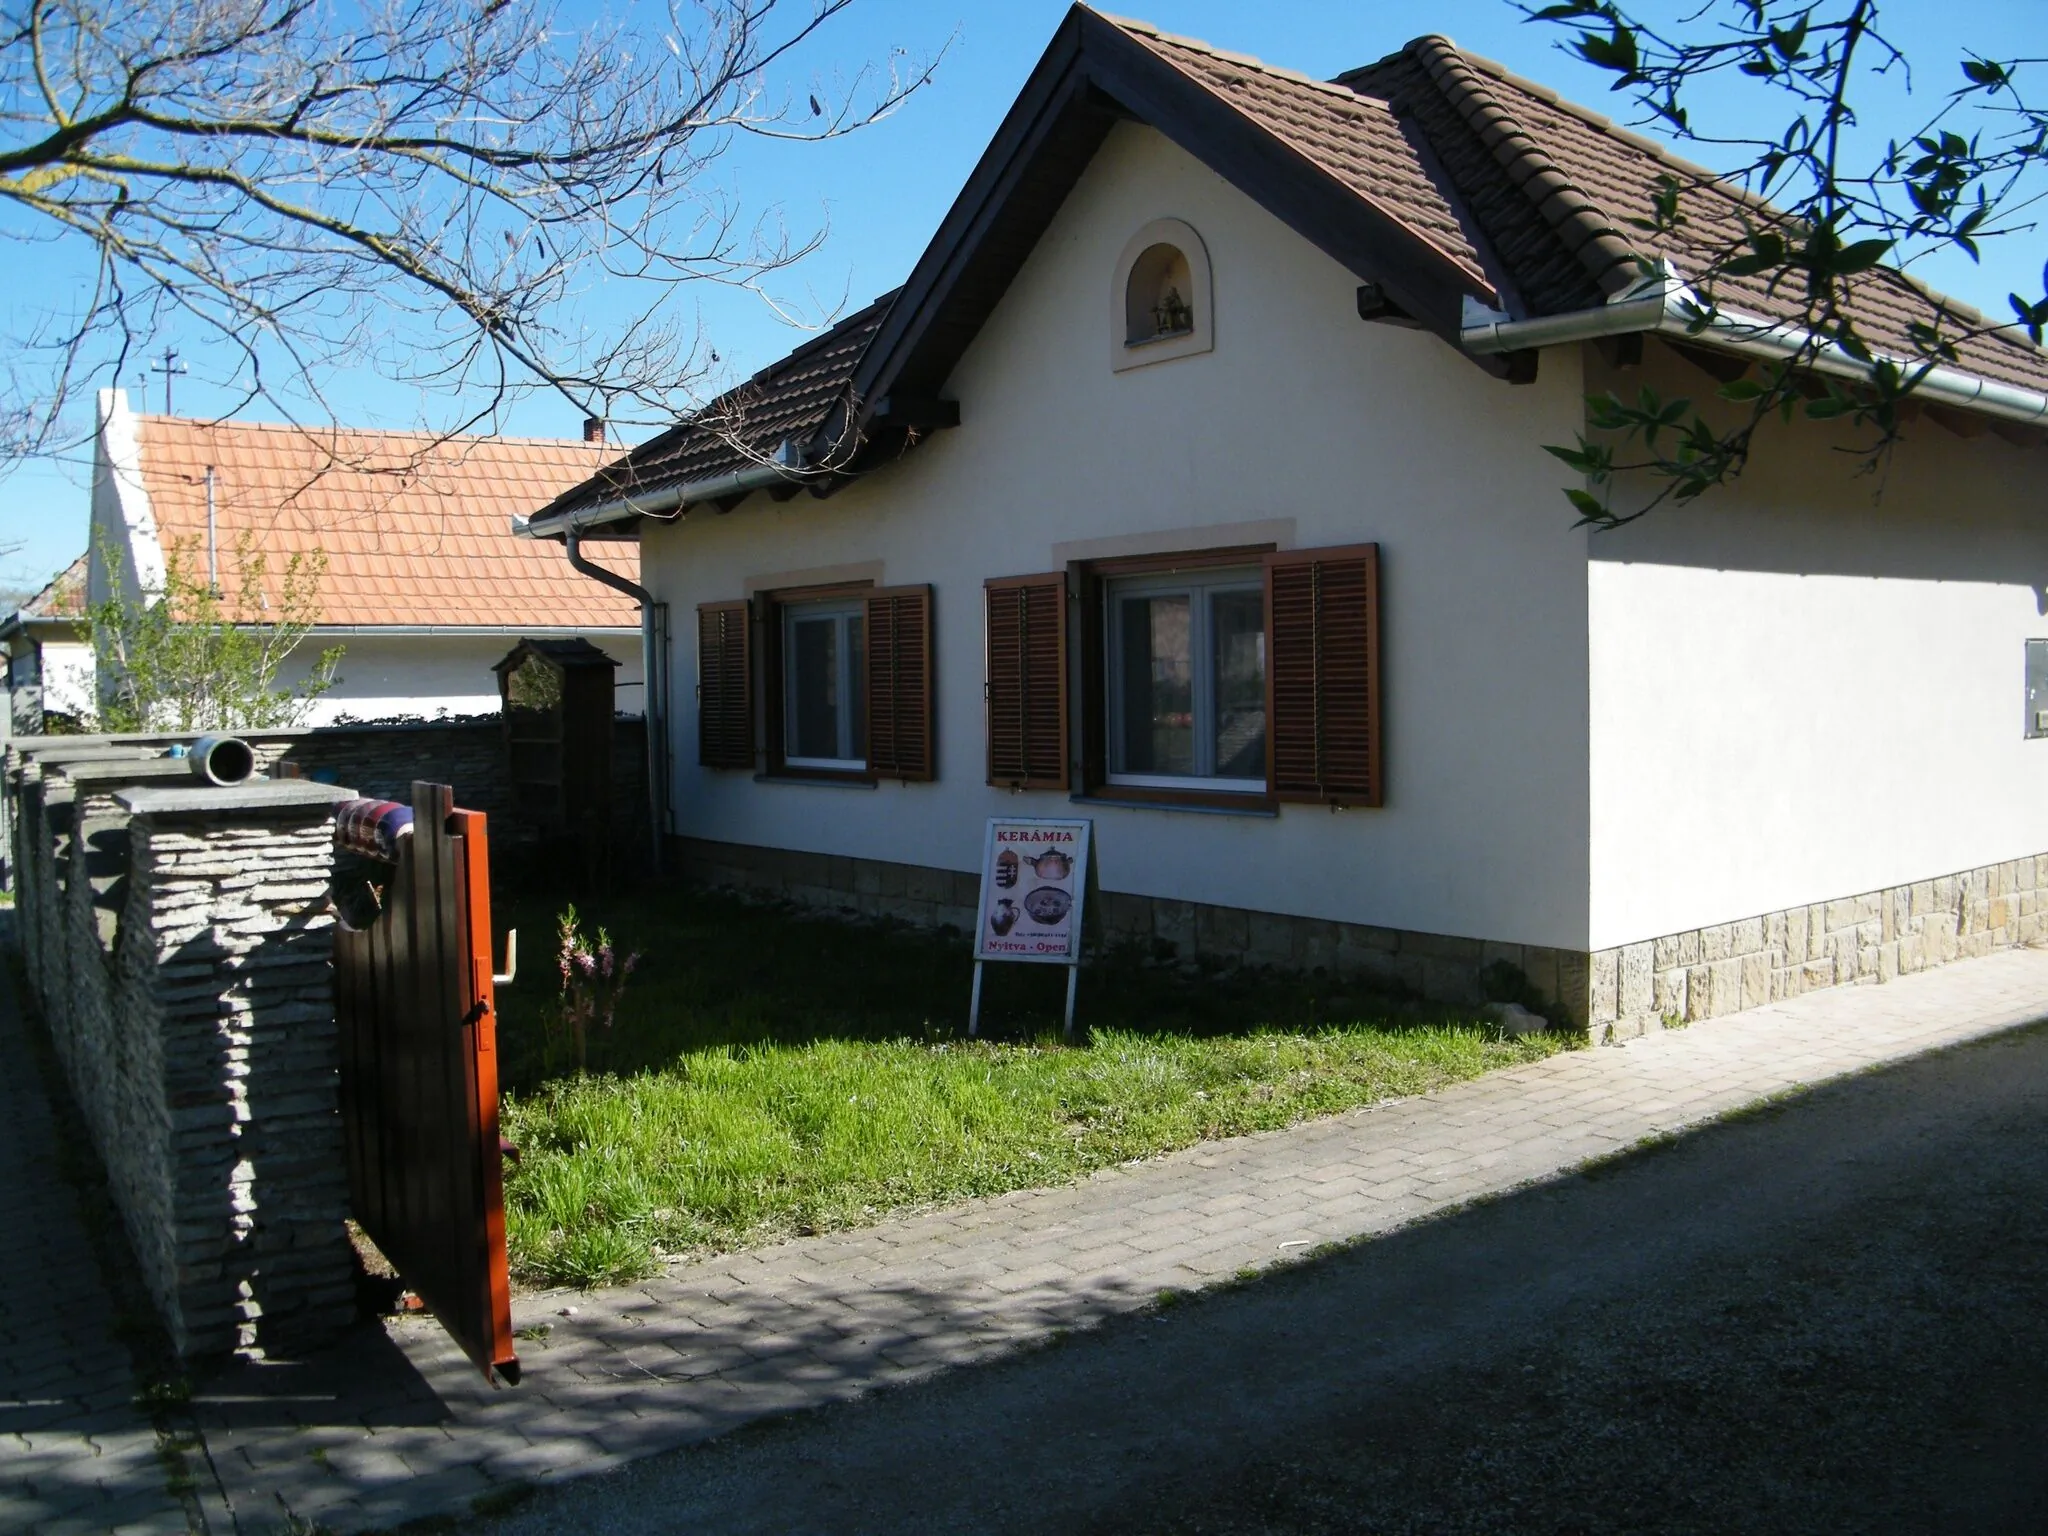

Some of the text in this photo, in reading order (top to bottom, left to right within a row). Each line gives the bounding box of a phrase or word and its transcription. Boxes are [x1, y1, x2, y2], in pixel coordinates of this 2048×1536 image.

[997, 829, 1074, 842] KERÁMIA
[988, 940, 1026, 952] Nyitva
[1036, 942, 1067, 953] Open
